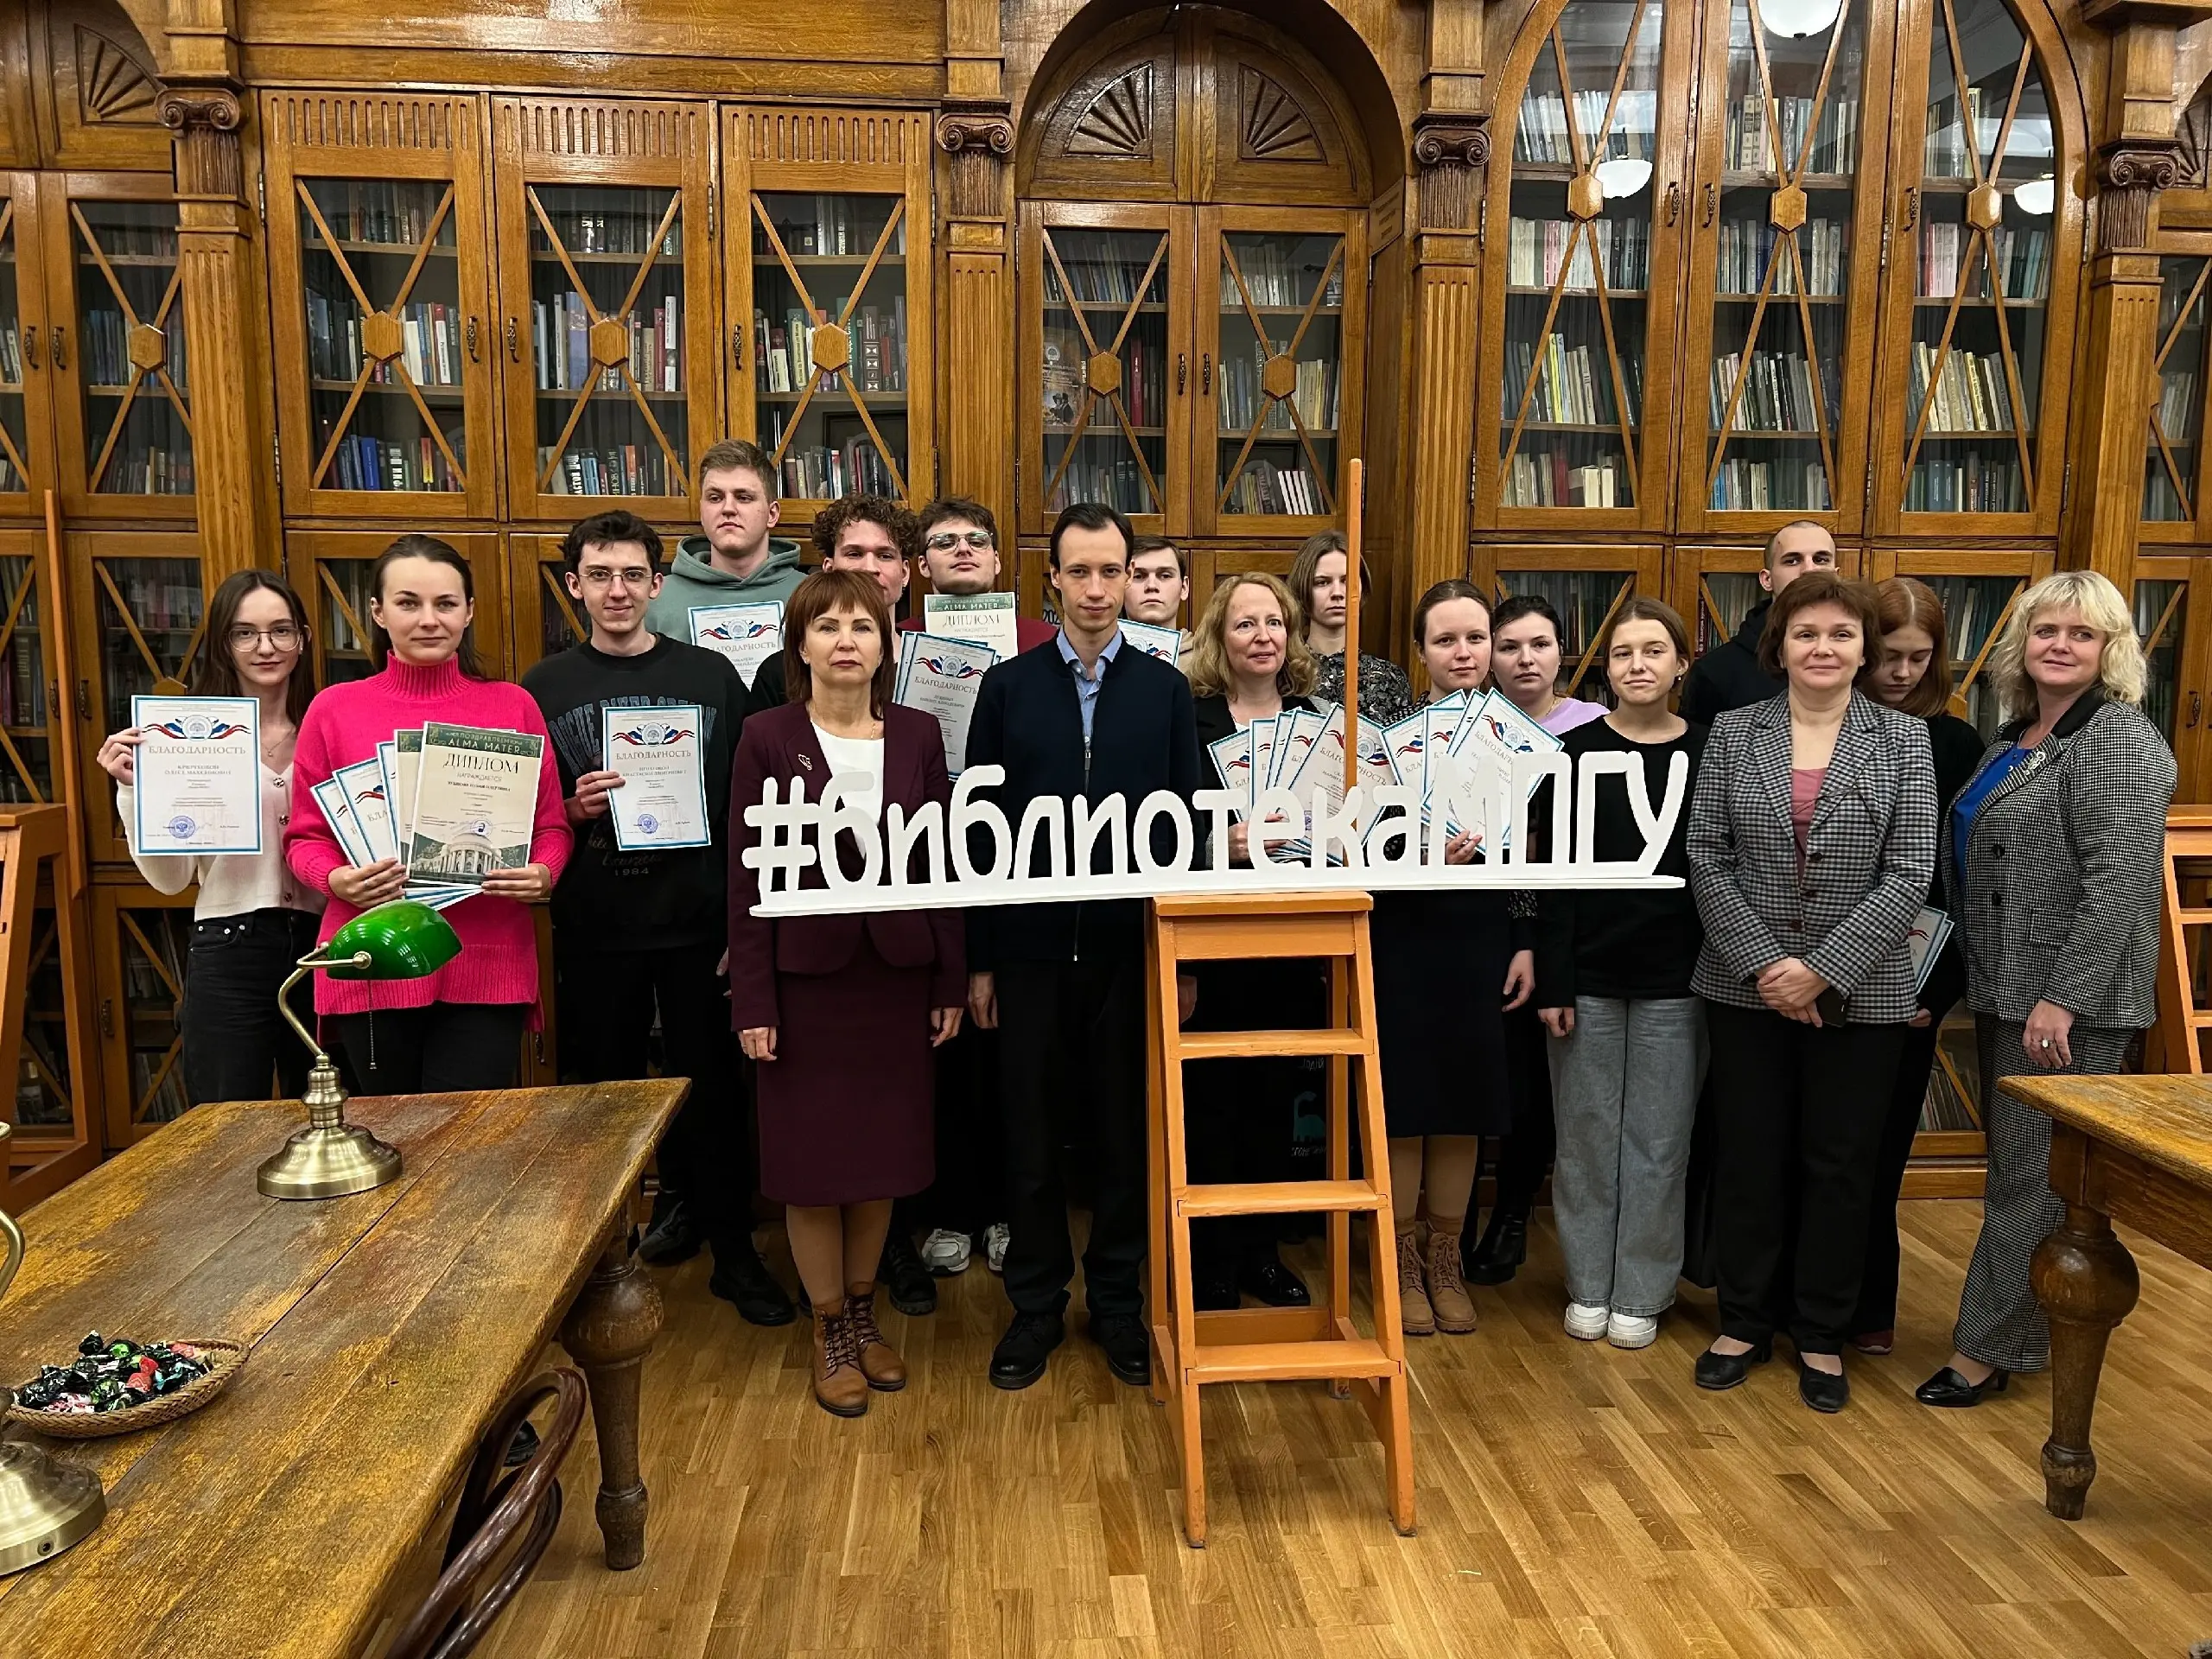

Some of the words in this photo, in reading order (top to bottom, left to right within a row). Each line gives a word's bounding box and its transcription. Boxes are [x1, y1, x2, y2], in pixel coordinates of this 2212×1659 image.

[943, 613, 1000, 627] ДИПЛОМ
[711, 642, 776, 652] ЛАГОДАРНОСТЬ
[914, 676, 977, 695] БЛАГОДАРНОСТЬ
[149, 746, 246, 755] БЛАГОДАРНОСТЬ
[448, 738, 479, 750] ALMA
[484, 742, 520, 753] MATER
[616, 750, 691, 760] БЛАГОДАРНОСТЬ
[442, 753, 518, 774] ДИПЛОМ
[742, 751, 1689, 895] #библиотекаМПГУ
[614, 867, 650, 876] 1984
